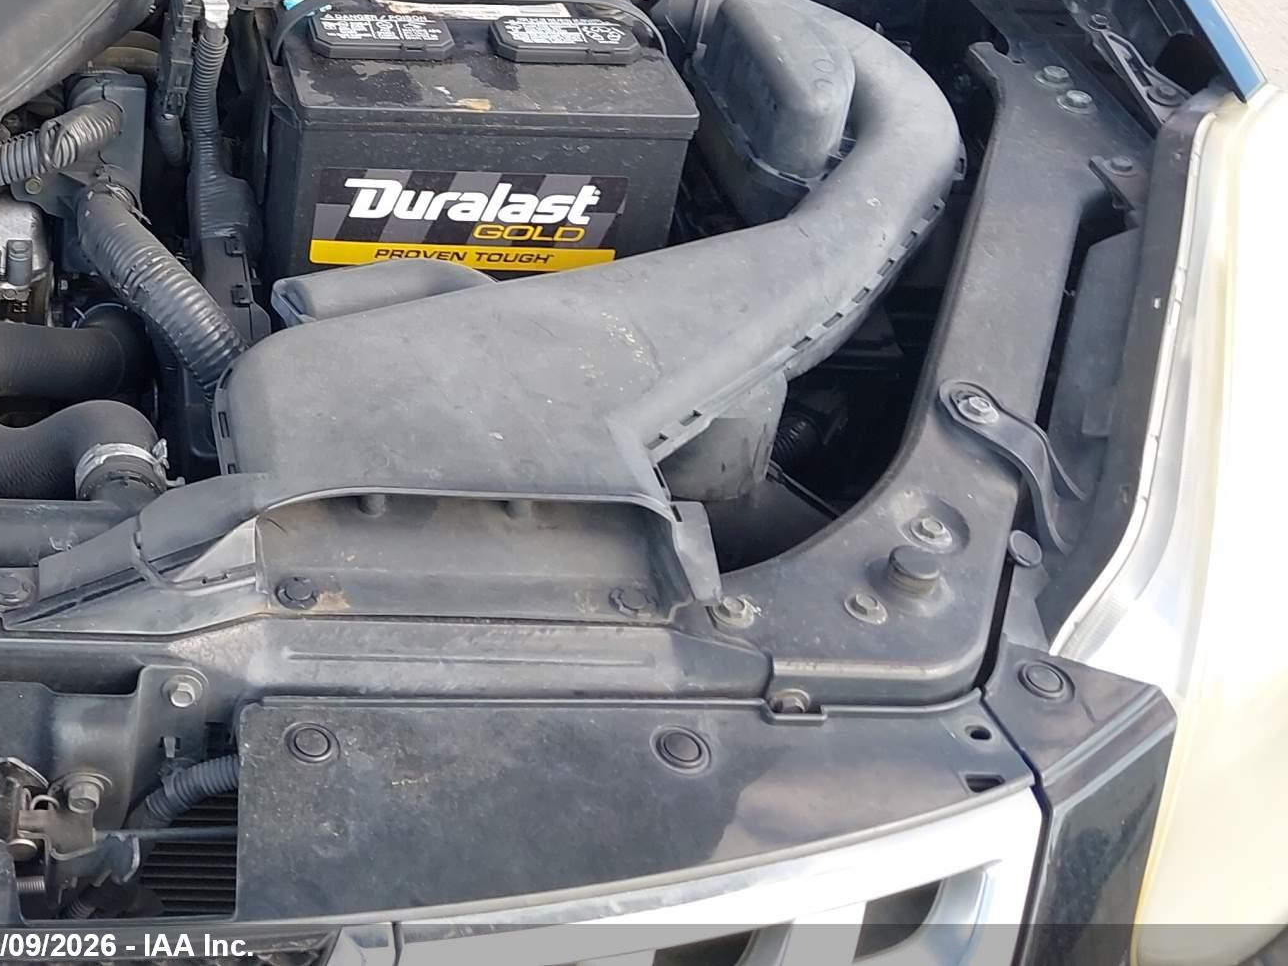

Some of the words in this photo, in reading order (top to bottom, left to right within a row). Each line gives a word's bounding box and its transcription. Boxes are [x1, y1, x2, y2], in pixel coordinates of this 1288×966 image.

[344, 178, 601, 225] Duralast
[472, 224, 585, 242] GOLD
[374, 248, 468, 262] PROVEN
